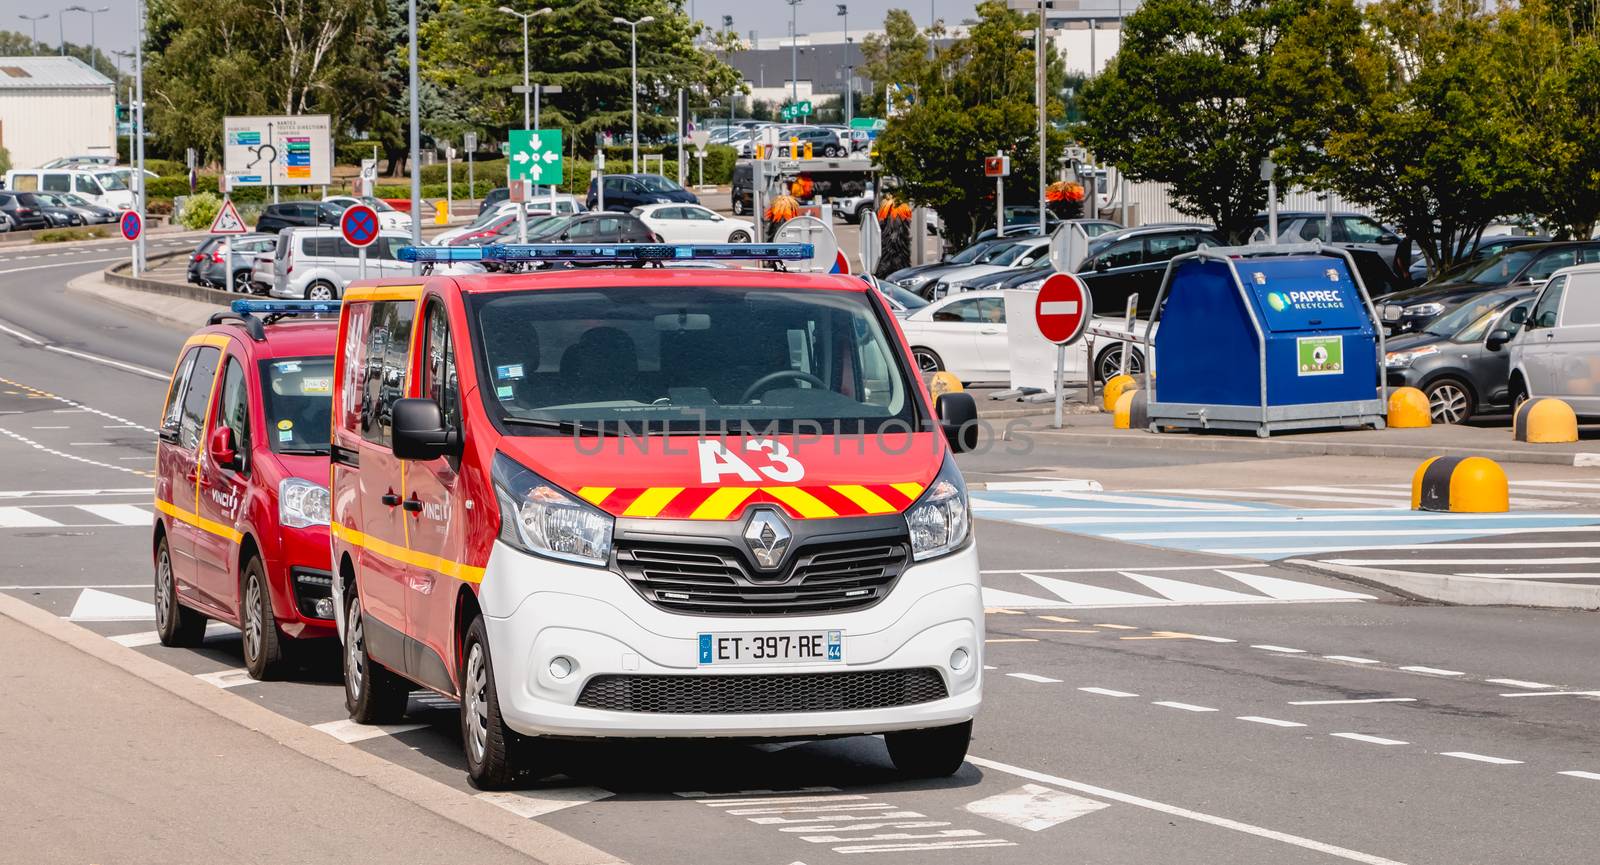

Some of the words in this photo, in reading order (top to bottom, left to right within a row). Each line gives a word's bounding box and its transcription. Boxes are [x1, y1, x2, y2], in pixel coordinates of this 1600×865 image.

[791, 106, 798, 115] 5
[801, 103, 810, 113] 4
[1290, 290, 1342, 302] PAPREC
[698, 439, 805, 484] A3
[211, 487, 229, 508] VINCI
[421, 500, 443, 521] VINCI
[703, 651, 708, 659] F
[828, 646, 841, 658] 44
